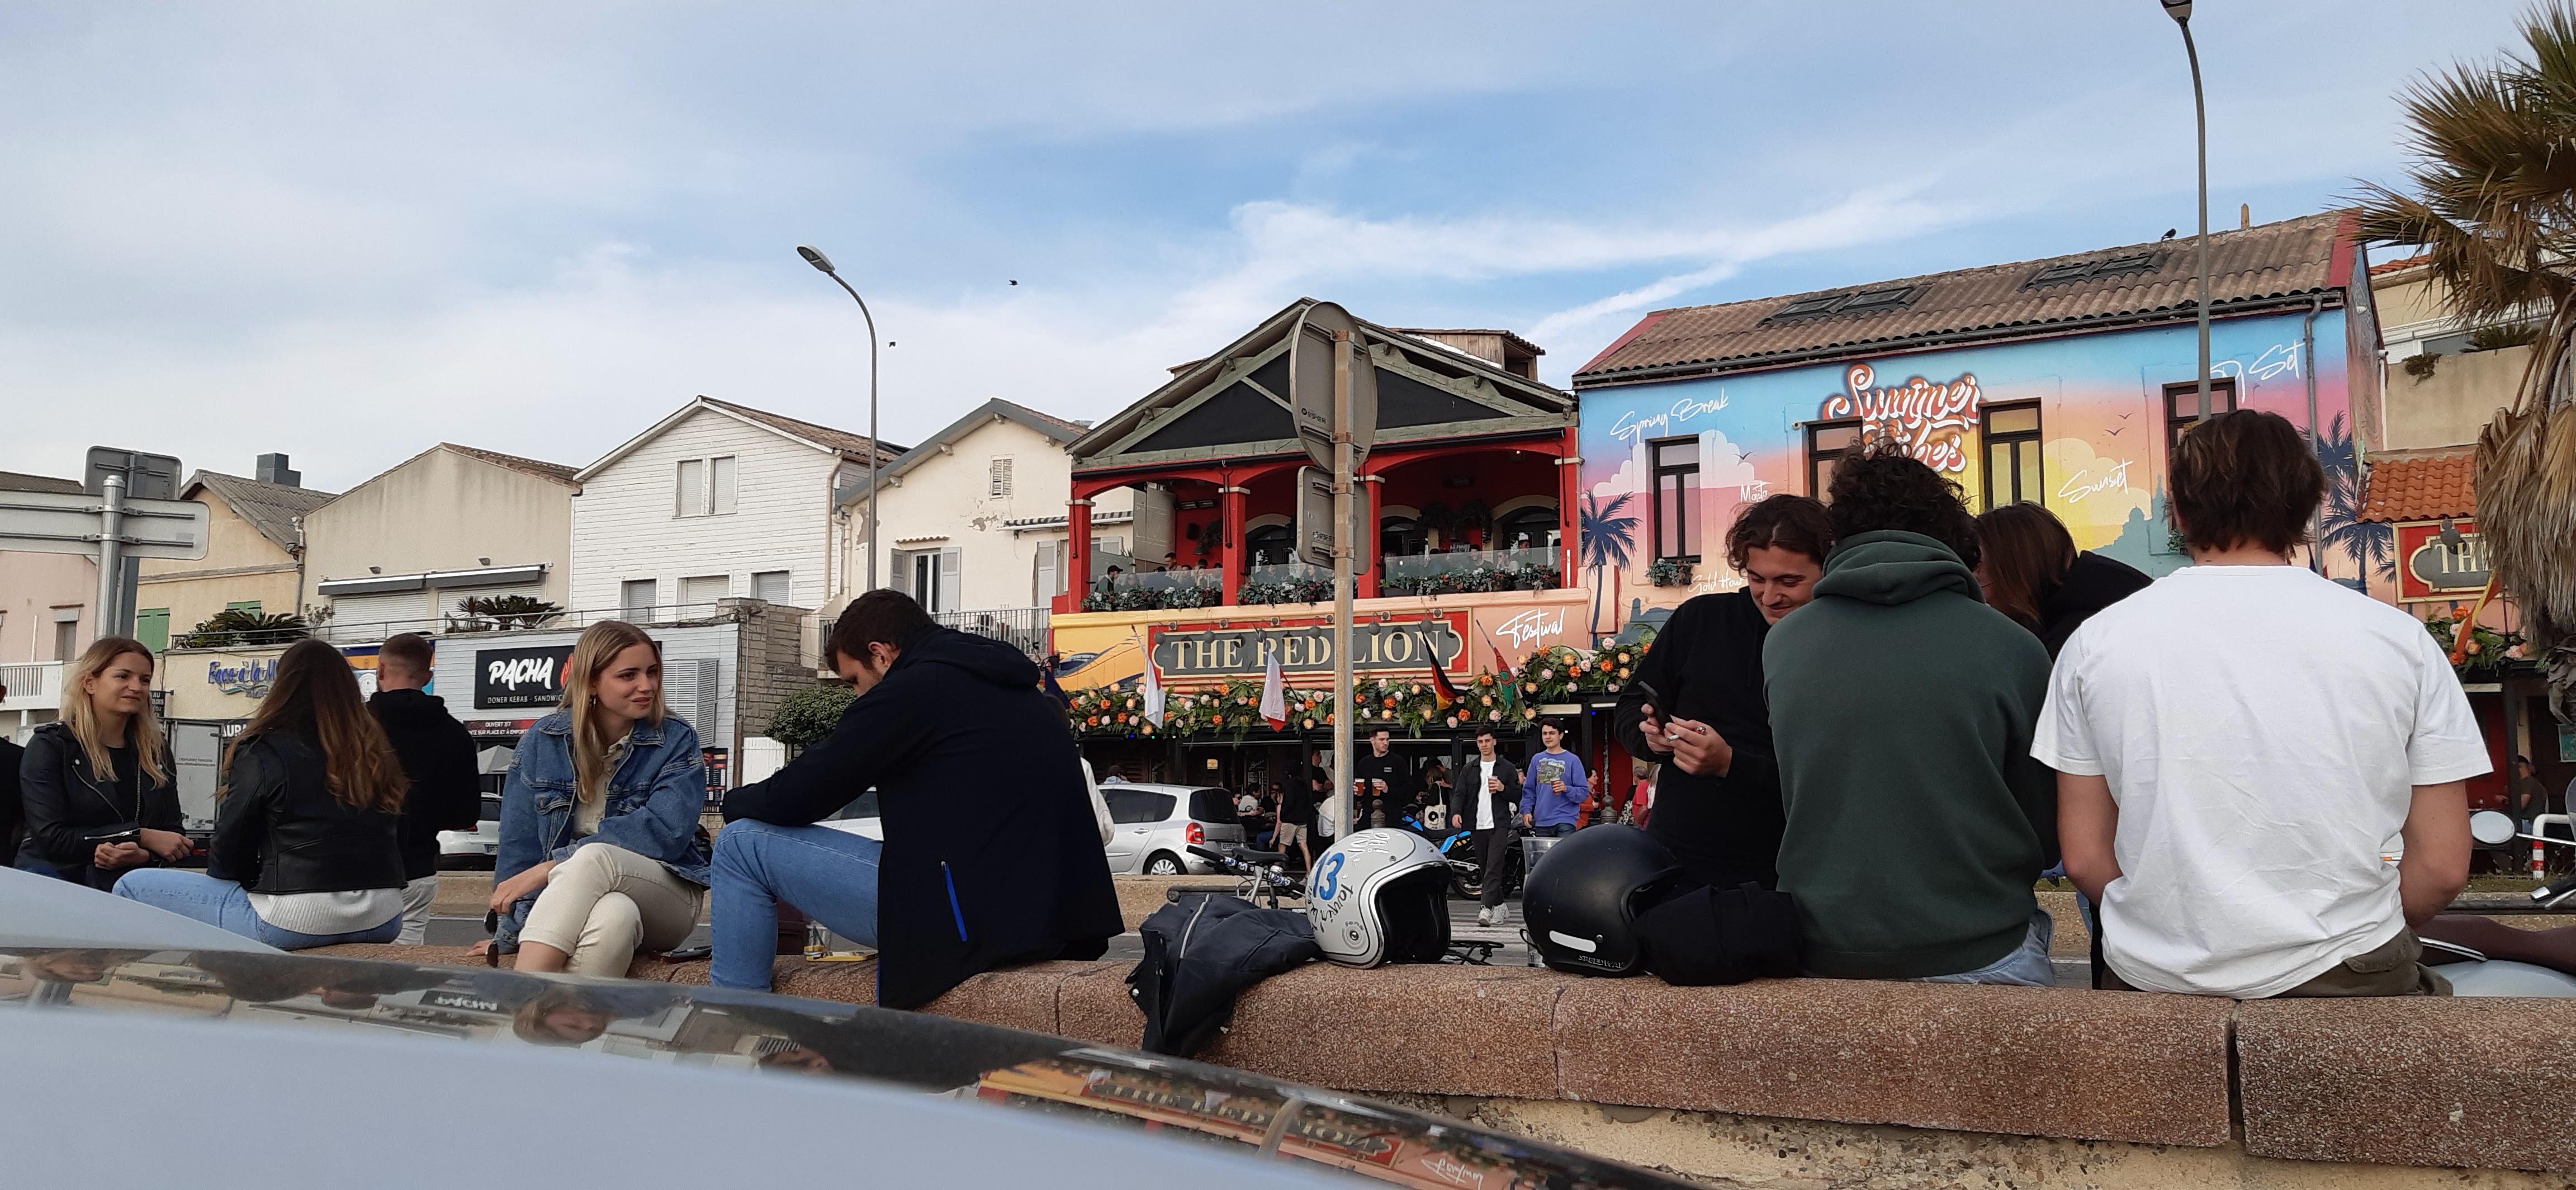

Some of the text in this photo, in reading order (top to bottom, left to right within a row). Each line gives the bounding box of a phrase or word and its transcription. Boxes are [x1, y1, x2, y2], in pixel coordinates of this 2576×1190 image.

[2248, 339, 2305, 380] Set
[1610, 387, 1729, 443] Spring Break
[1822, 364, 1981, 429] Summer
[1740, 480, 1773, 504] Mojito
[2058, 457, 2134, 503] Sunset
[1688, 568, 1744, 596] Gold Hour
[1496, 606, 1565, 649] Festival
[208, 661, 237, 683] Face
[238, 661, 249, 682] à
[250, 659, 265, 682] la
[1171, 635, 1243, 669] THE
[1254, 634, 1332, 667] RED
[489, 657, 554, 691] PACHA
[1313, 851, 1345, 901] 13
